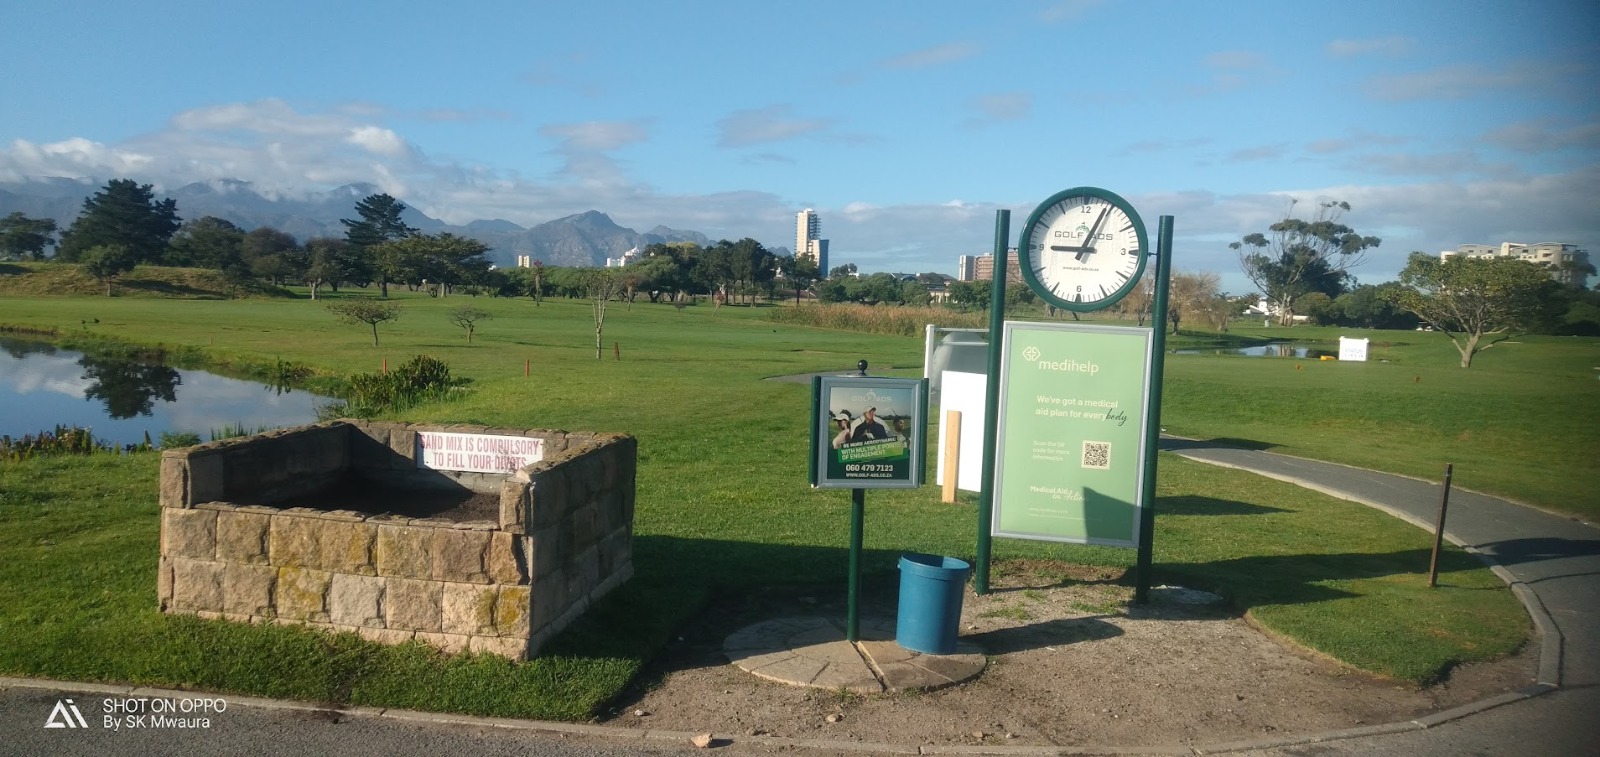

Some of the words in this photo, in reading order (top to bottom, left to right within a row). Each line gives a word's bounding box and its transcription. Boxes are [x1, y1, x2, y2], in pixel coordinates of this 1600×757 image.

[1080, 206, 1091, 214] 12
[1054, 231, 1084, 239] GOLF
[1120, 248, 1126, 256] 3
[1039, 359, 1099, 376] medihelp
[1037, 395, 1060, 404] We've
[1062, 398, 1076, 406] got
[1085, 400, 1118, 408] medical
[1036, 408, 1048, 416] aid
[1050, 409, 1068, 417] plan
[1070, 410, 1081, 418] for
[1084, 408, 1128, 426] everybody
[420, 434, 442, 449] SAND
[446, 436, 462, 451] MIX
[466, 437, 474, 452] IS
[477, 438, 539, 455] COMPULSORY
[856, 445, 881, 454] MULTIPLE
[434, 452, 444, 466] TO
[447, 453, 464, 468] FILL
[468, 454, 491, 470] YOUR
[876, 464, 893, 472] 7123
[1030, 486, 1056, 494] Medical
